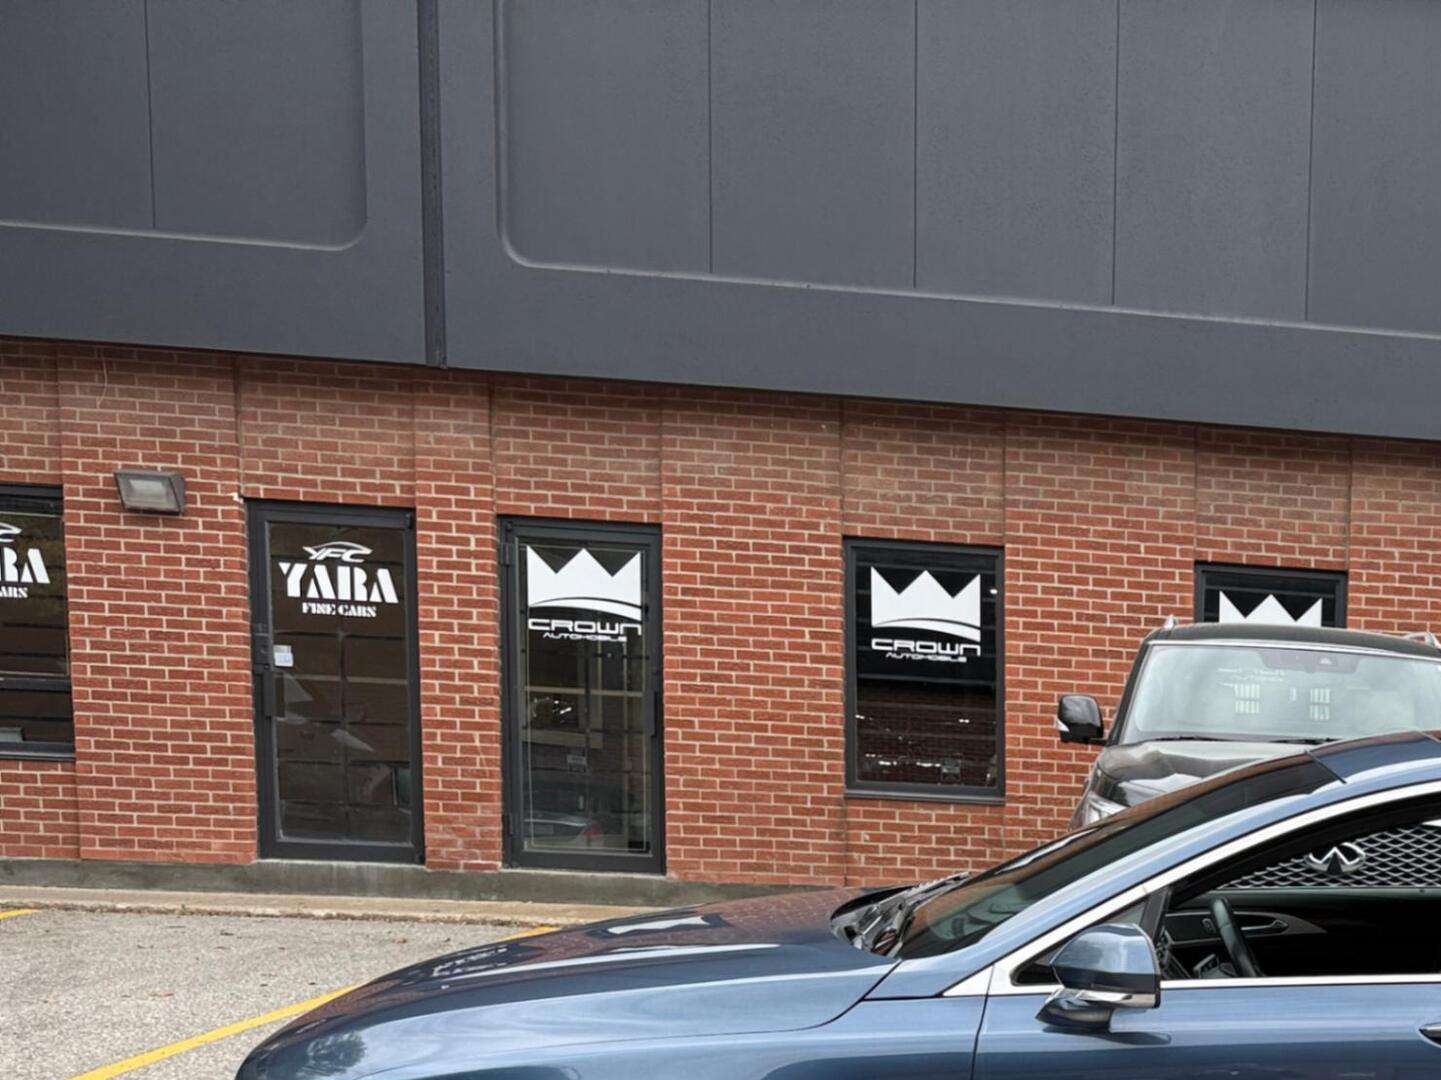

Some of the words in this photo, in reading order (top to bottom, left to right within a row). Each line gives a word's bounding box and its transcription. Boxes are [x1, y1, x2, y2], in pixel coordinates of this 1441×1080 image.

[0, 546, 51, 584] RA
[278, 561, 399, 604] YARA
[0, 585, 28, 599] ARS
[302, 602, 337, 616] FINE
[337, 603, 377, 618] CARS
[527, 618, 642, 636] CROWN
[871, 638, 981, 657] CROWN
